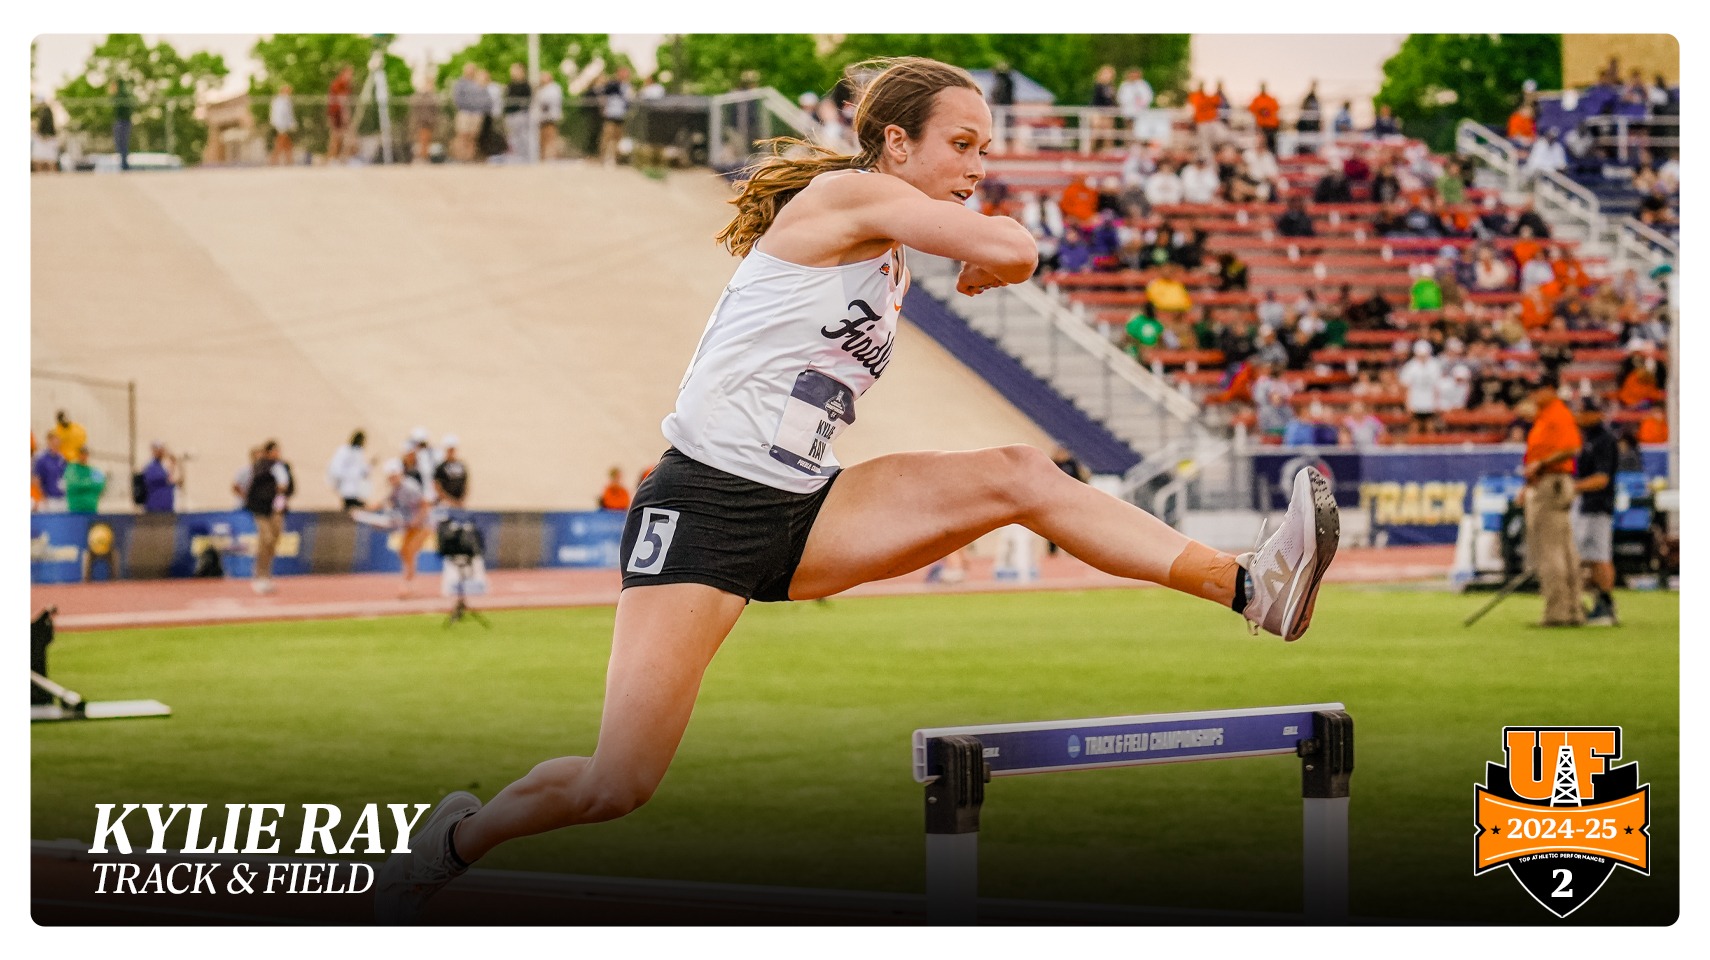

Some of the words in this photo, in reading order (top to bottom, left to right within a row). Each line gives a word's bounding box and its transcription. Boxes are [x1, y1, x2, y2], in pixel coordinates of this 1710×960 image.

[808, 437, 827, 461] RAY
[1360, 481, 1466, 526] TRACK
[634, 513, 670, 568] 5
[1085, 735, 1116, 756] TRACK
[1123, 732, 1149, 752] FIELD
[1150, 727, 1224, 751] CHAMPIONSHIPS
